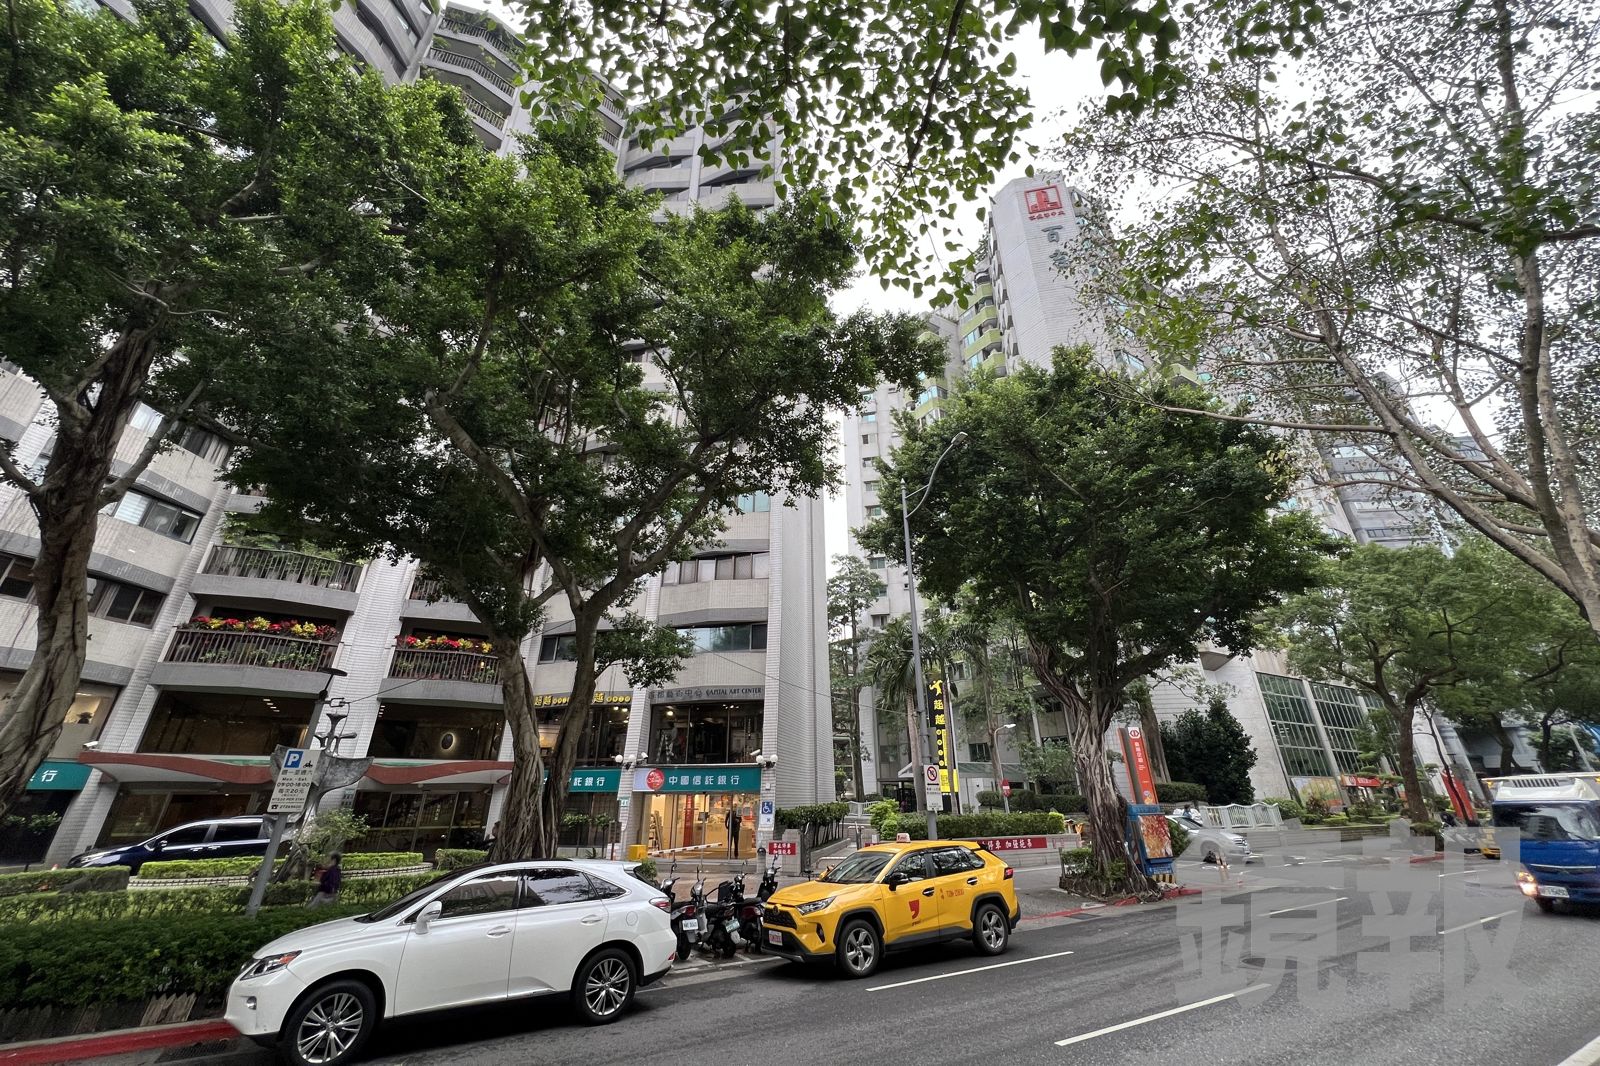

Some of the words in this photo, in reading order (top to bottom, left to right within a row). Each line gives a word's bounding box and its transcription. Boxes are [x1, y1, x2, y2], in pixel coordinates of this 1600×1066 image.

[705, 688, 728, 697] CAPITAL
[729, 687, 740, 695] ART
[741, 686, 762, 694] CENTER
[287, 754, 299, 765] P
[668, 775, 740, 786] 中國信託銀行
